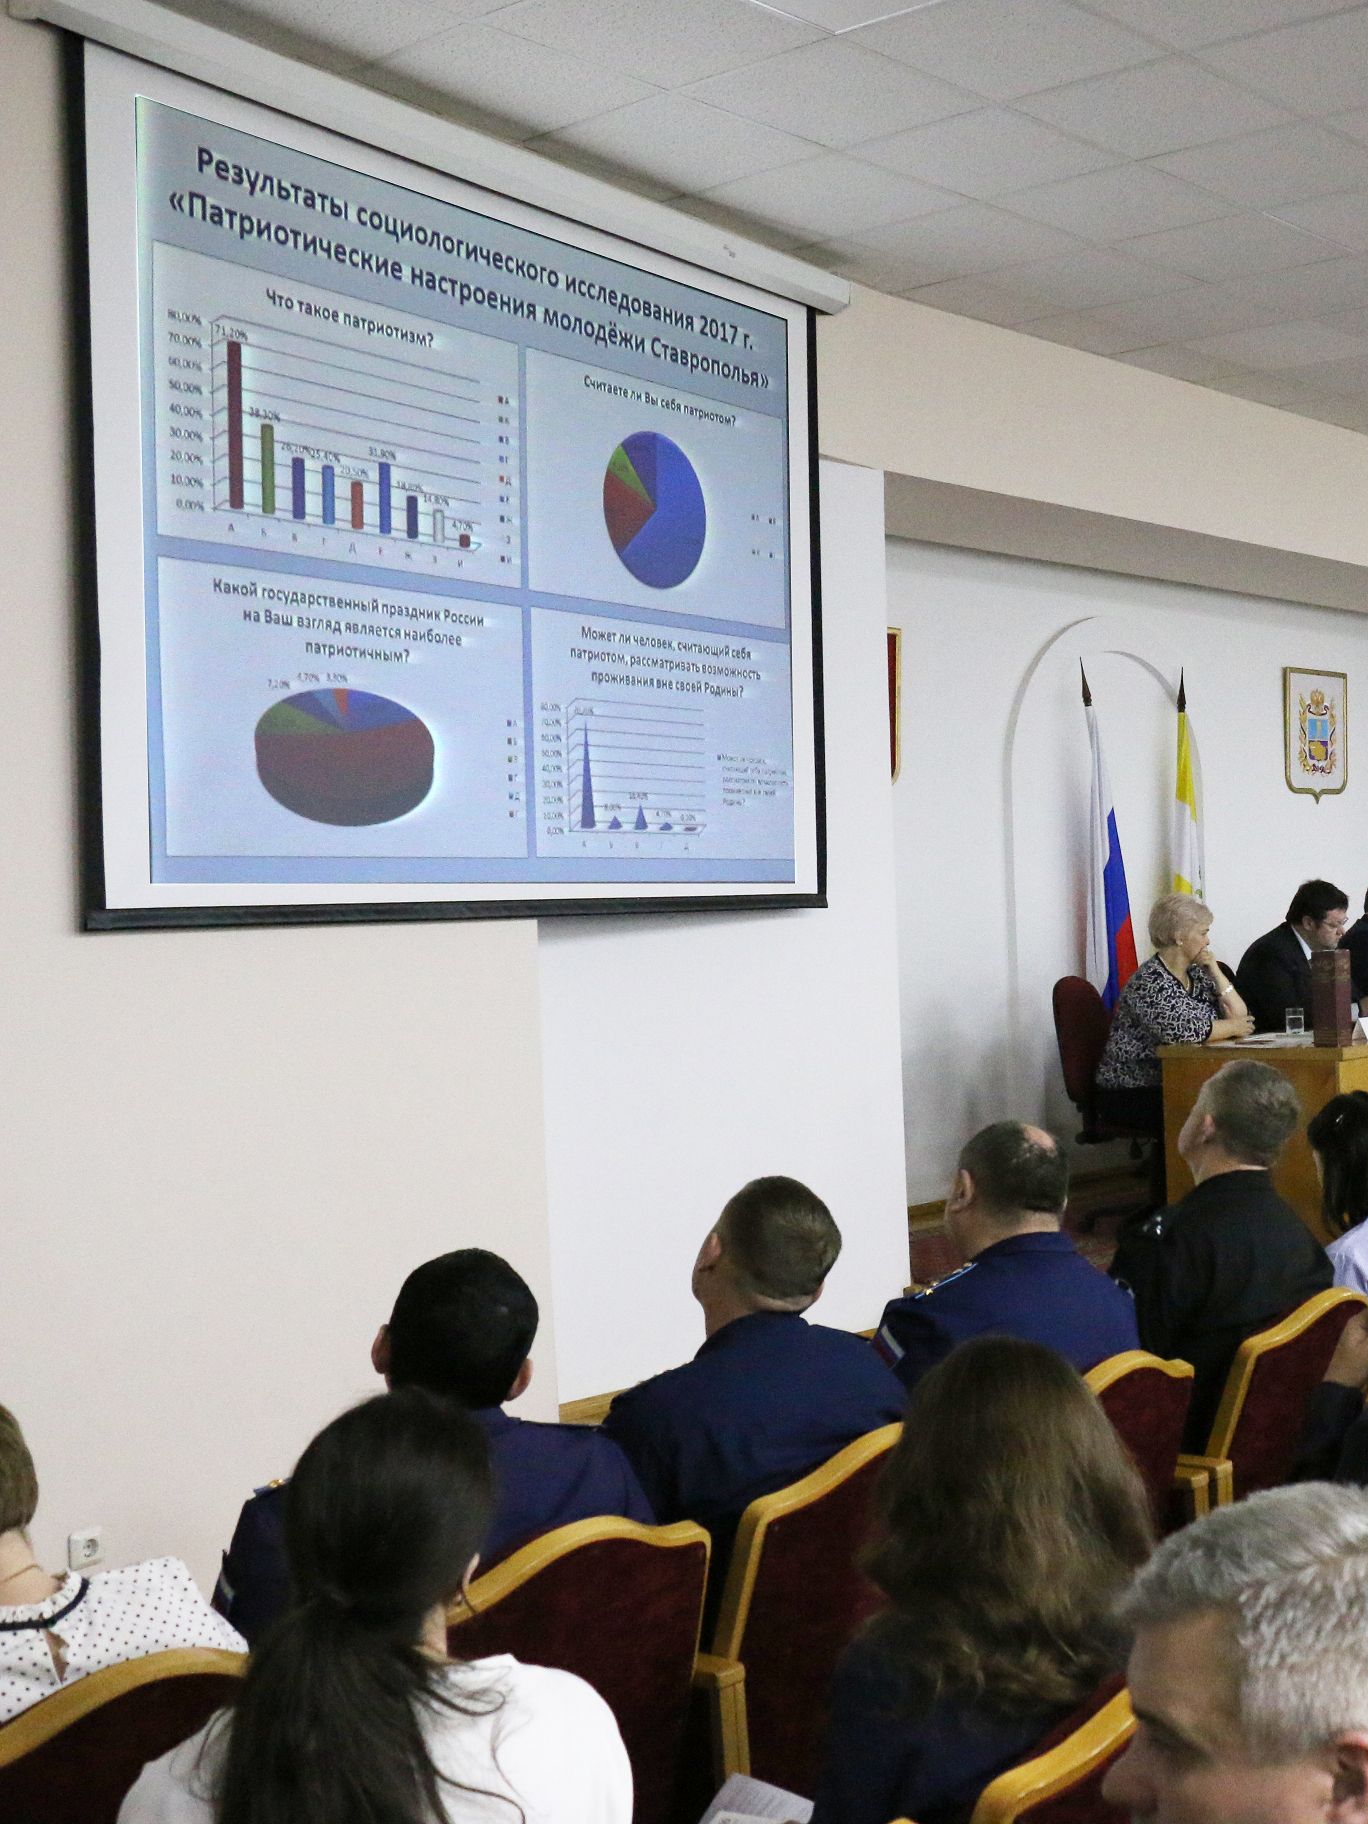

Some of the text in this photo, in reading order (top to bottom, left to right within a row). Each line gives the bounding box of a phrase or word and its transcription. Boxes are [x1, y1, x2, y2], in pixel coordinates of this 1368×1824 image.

[197, 146, 753, 350] Результаты социологического исследования 2017 г.
[169, 191, 769, 389] «Патриотические настроения молодёжи Ставрополья»
[266, 288, 434, 349] Что такое патриотизм?
[584, 375, 736, 427] Считаете ли Вы себя патриотом?
[213, 577, 484, 627] Какой государственный праздник России
[243, 609, 462, 647] на Ваш взгляд является наиболее
[581, 626, 751, 661] Может ли человек, считающий себя
[306, 641, 410, 664] патриотичным?
[570, 648, 761, 681] патриотом, рассматривать возможность
[592, 671, 743, 698] проживания вне своей Родины?
